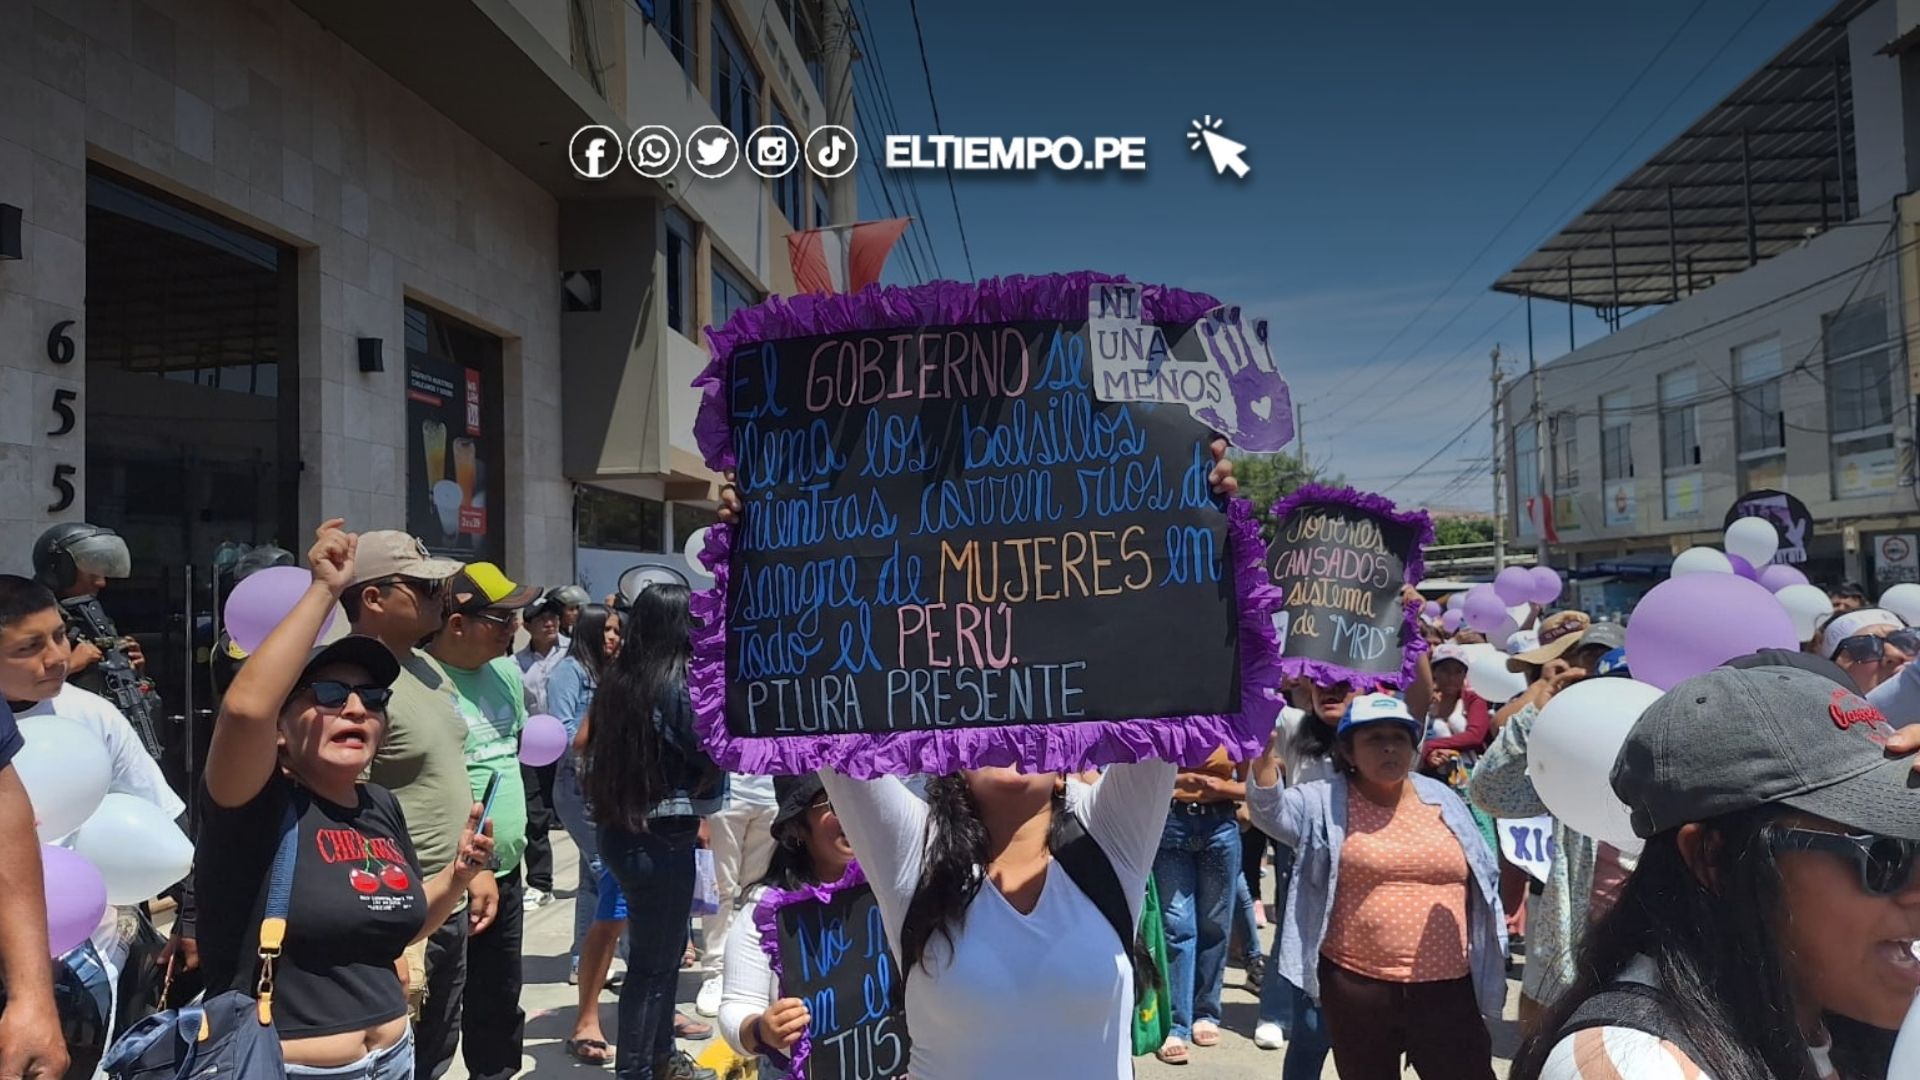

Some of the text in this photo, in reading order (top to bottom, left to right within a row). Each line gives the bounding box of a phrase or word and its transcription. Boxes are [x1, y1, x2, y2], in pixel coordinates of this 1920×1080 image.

[1097, 285, 1137, 319] NI
[732, 329, 1088, 418] El GOBIERNO se
[1097, 327, 1171, 362] UNA
[1102, 368, 1223, 403] MENOS
[733, 392, 1147, 494] llena los bolsillos
[909, 470, 1063, 535] corren
[729, 524, 1222, 638] sangre de MUJERES en
[1273, 546, 1390, 589] CANSADOS
[1284, 577, 1377, 618] sistema
[829, 601, 884, 674] el
[897, 602, 1019, 670] PERÚ.
[1290, 608, 1321, 637] de
[747, 660, 1087, 734] PIURA PRESENTE
[1509, 826, 1553, 862] XI
[797, 905, 853, 982] No
[855, 953, 891, 1025] el
[823, 1015, 902, 1080] TUS
